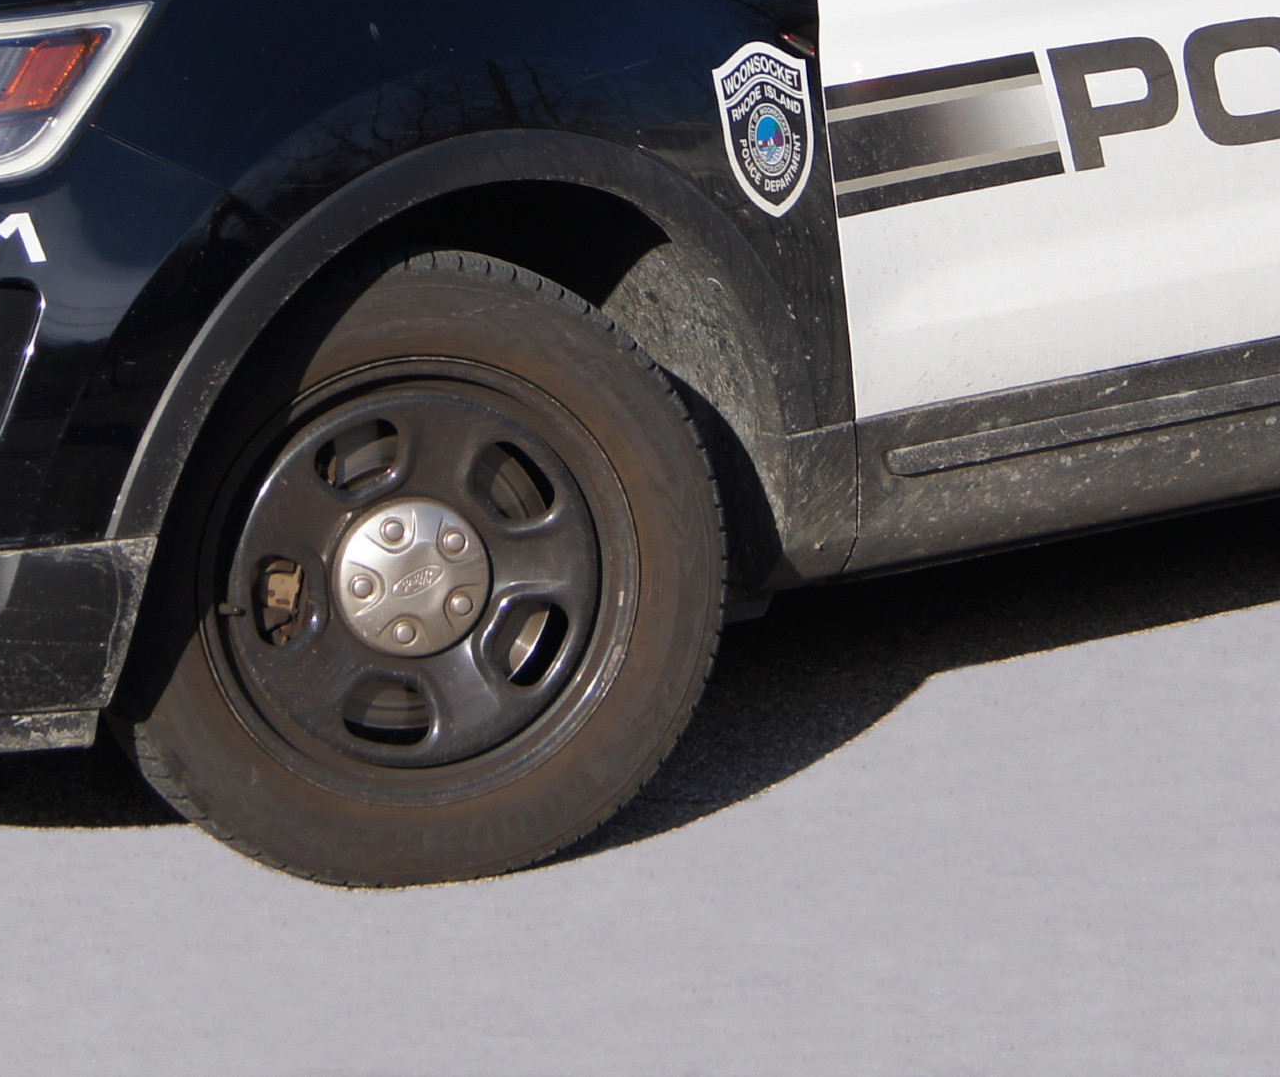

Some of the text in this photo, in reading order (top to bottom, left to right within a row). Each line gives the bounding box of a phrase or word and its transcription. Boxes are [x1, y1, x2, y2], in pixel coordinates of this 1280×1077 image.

[723, 55, 798, 95] WOONSOCKET
[731, 84, 801, 122] RHODE ISLAND
[740, 133, 801, 192] POLICE DEPARTMENT
